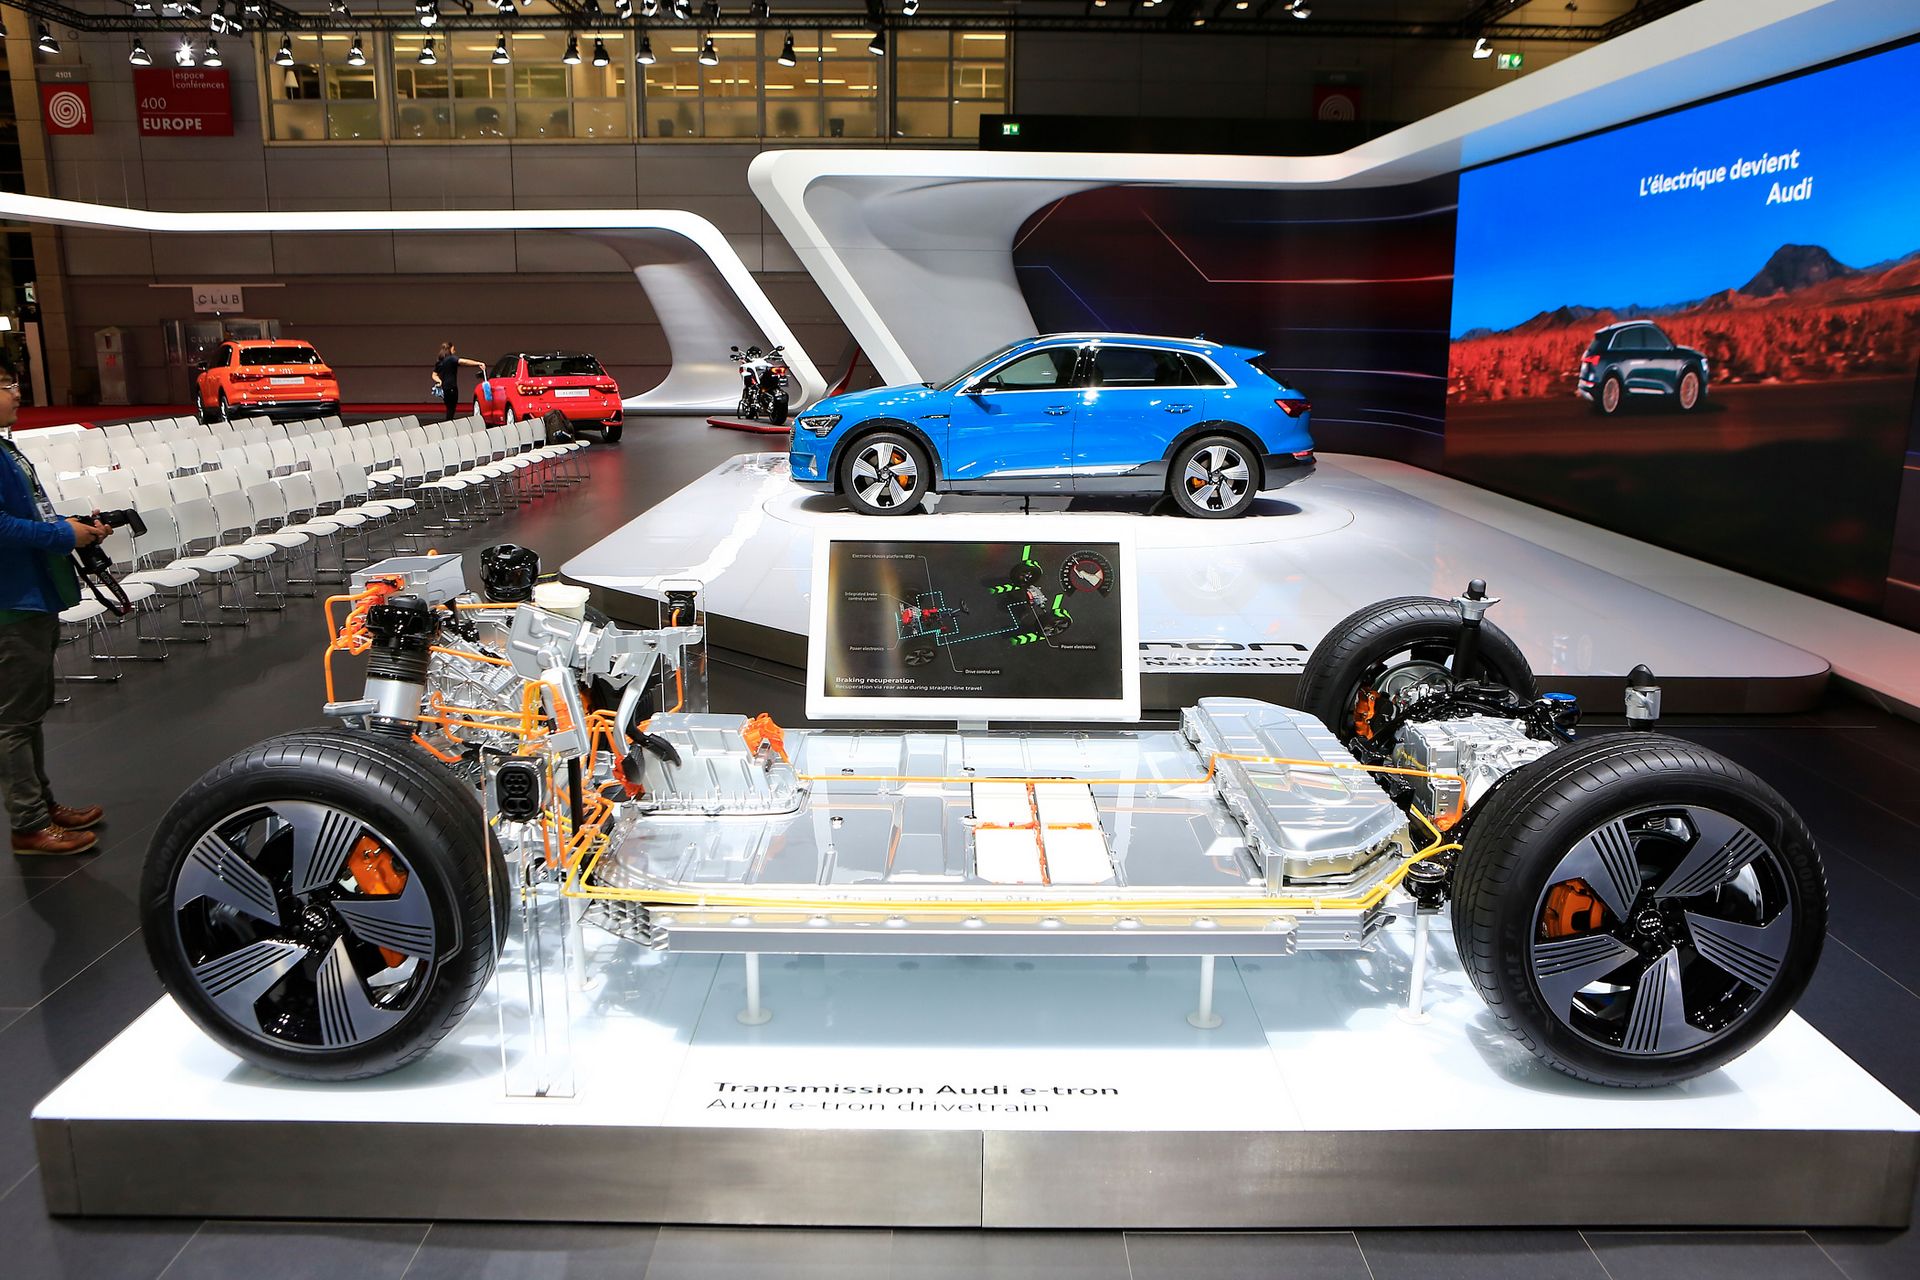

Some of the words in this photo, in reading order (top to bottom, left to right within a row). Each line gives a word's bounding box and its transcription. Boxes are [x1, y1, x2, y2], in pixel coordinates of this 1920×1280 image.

[174, 72, 205, 81] espace
[175, 80, 225, 89] conférences
[141, 97, 167, 110] 400
[143, 118, 202, 130] EUROPE
[1639, 167, 1727, 197] L'électrique
[1729, 148, 1800, 181] devient
[1766, 177, 1813, 205] Audi
[198, 294, 240, 304] CLUB
[835, 676, 865, 684] Braking
[714, 1082, 925, 1095] Transmission
[935, 1084, 1008, 1096] Audi
[1019, 1085, 1119, 1096] e-tron
[706, 1098, 777, 1111] Audi
[789, 1100, 885, 1112] e-tron
[898, 1100, 1049, 1113] drivetrain
